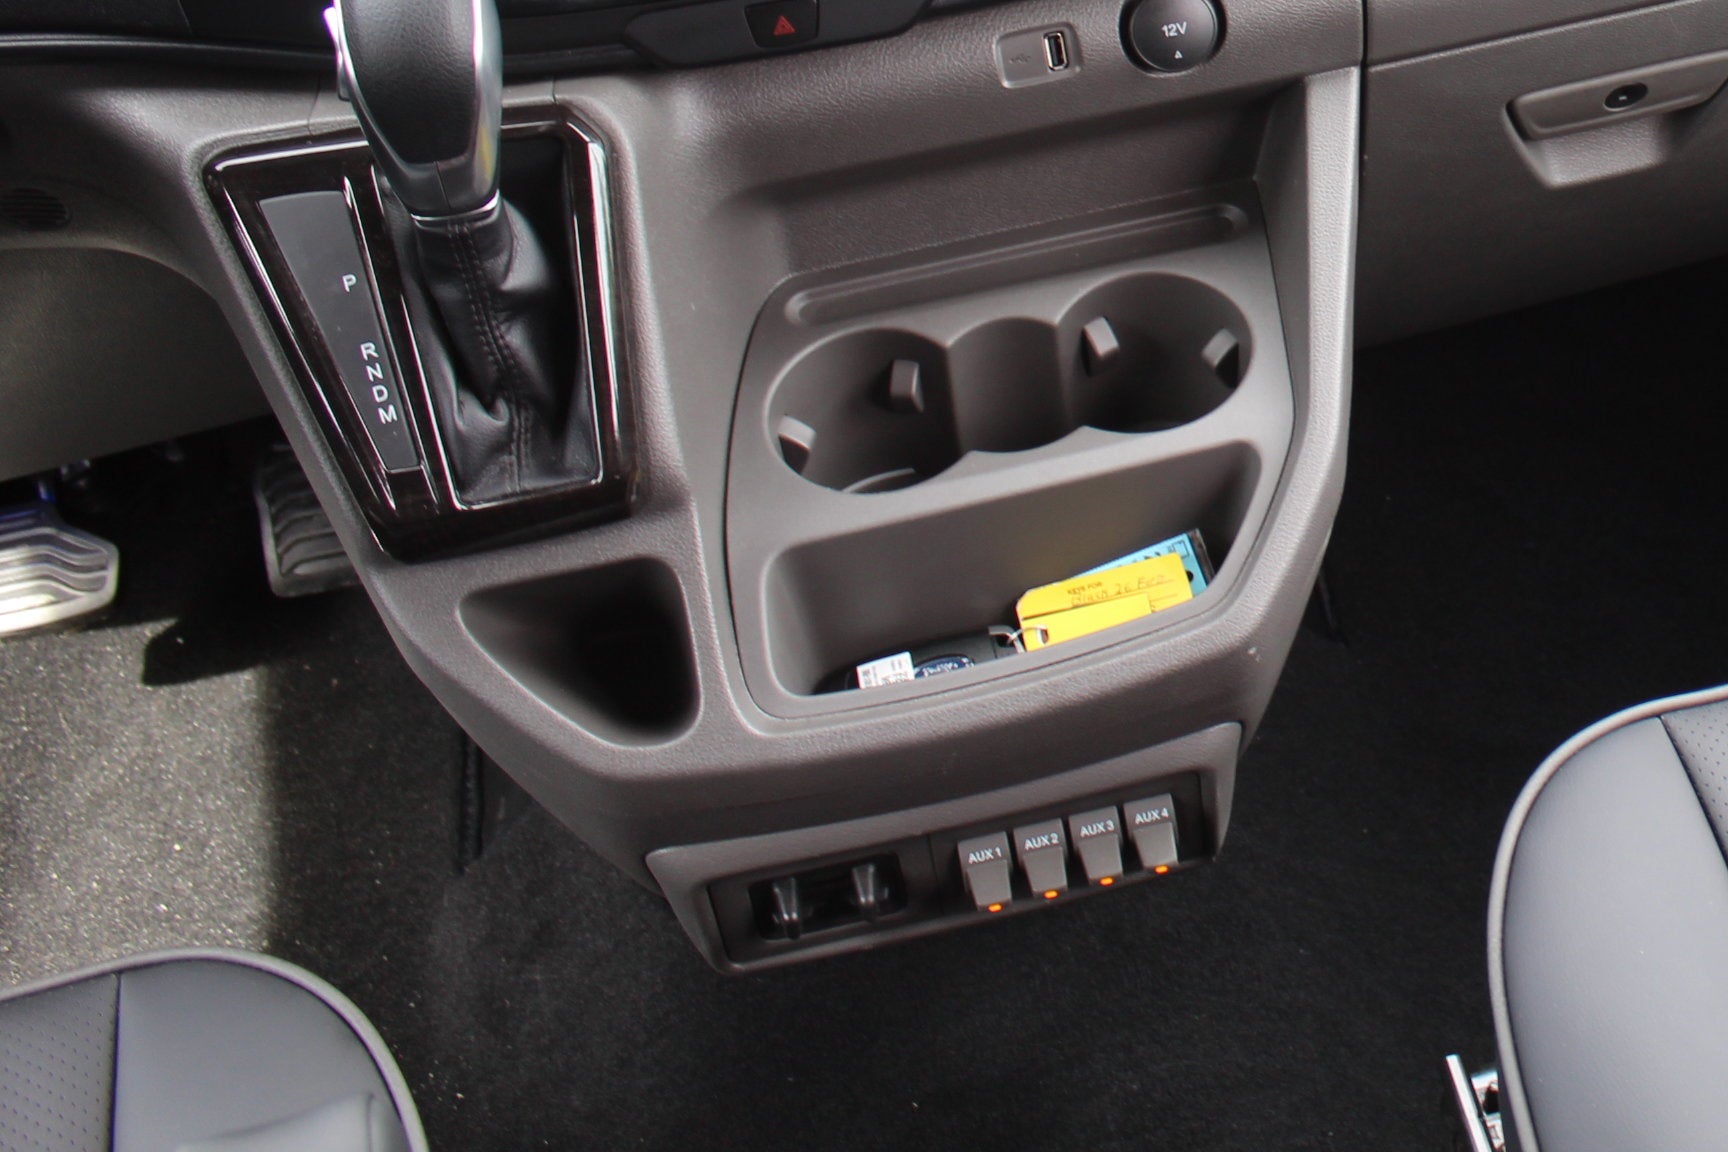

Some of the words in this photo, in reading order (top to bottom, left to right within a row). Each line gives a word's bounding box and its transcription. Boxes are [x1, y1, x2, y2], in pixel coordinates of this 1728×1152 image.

[1161, 22, 1187, 37] 12V
[342, 274, 357, 293] P
[360, 342, 379, 361] R
[366, 362, 384, 382] N
[371, 384, 389, 403] D
[378, 404, 398, 425] M
[1134, 811, 1160, 825] AUX
[1160, 807, 1169, 818] 4
[1079, 822, 1106, 837] AUX
[1107, 819, 1115, 832] 3
[1023, 836, 1049, 850] AUX
[1050, 832, 1059, 845] 2
[968, 850, 994, 864] AUX
[995, 847, 1002, 858] 1
